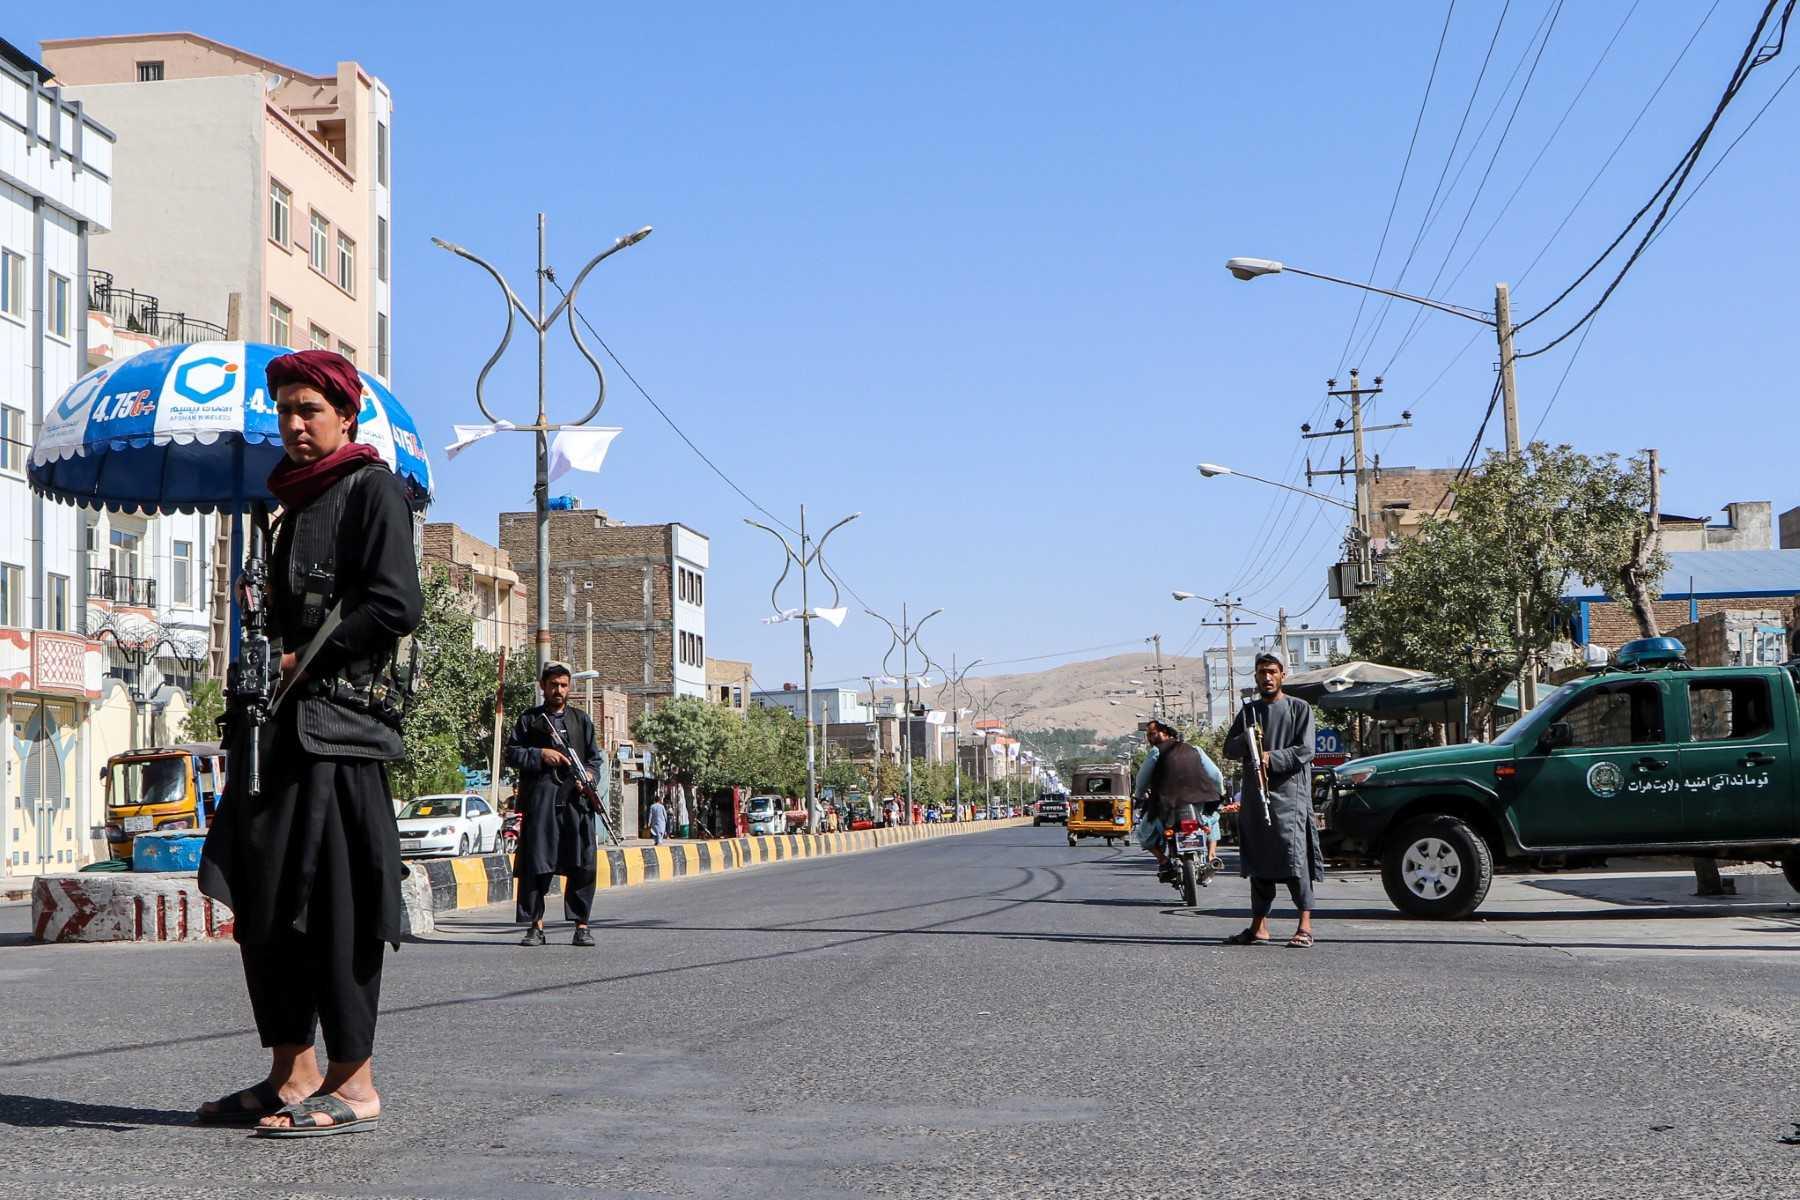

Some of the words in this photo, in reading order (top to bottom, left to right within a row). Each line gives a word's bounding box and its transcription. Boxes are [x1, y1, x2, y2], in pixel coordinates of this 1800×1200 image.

[1316, 735, 1337, 752] 30
[1628, 780, 1653, 793] هرات
[1653, 779, 1680, 793] ولایت
[1684, 776, 1710, 792] امنیه
